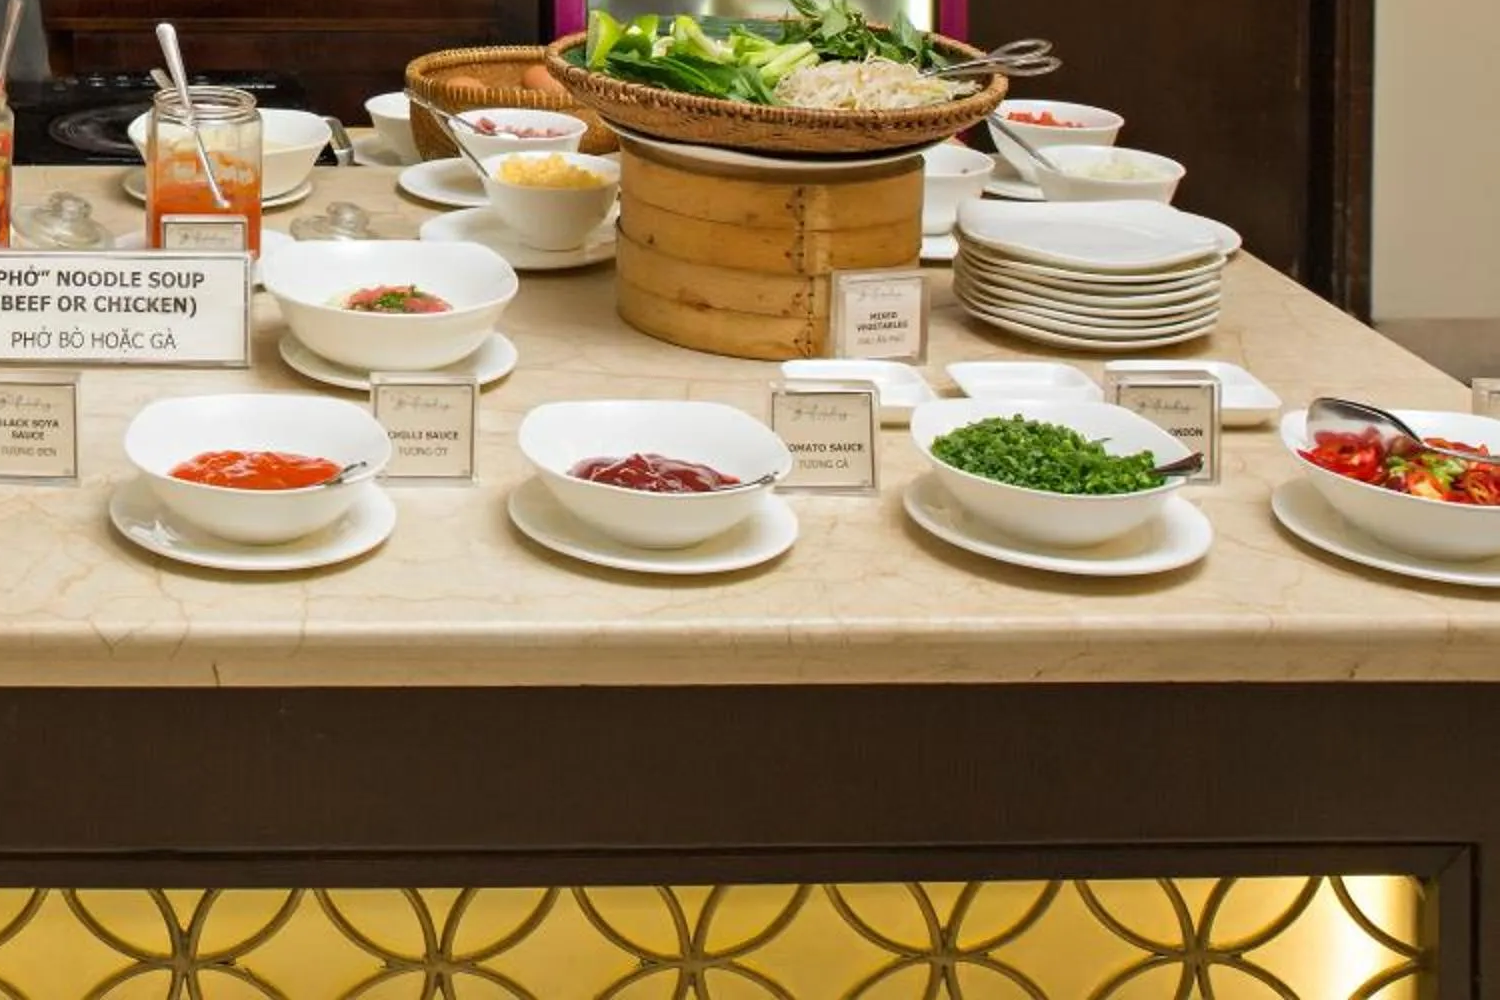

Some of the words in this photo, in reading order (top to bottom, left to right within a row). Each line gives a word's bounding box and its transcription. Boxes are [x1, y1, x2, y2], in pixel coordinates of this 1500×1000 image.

[56, 270, 142, 288] NOODLE
[148, 271, 205, 289] SOUP
[57, 295, 87, 312] OR
[93, 295, 197, 318] CHICKEN)
[91, 327, 145, 354] HOẶC
[150, 327, 177, 350] GÀ
[787, 443, 827, 452] OMATO
[829, 443, 864, 453] SAUCE
